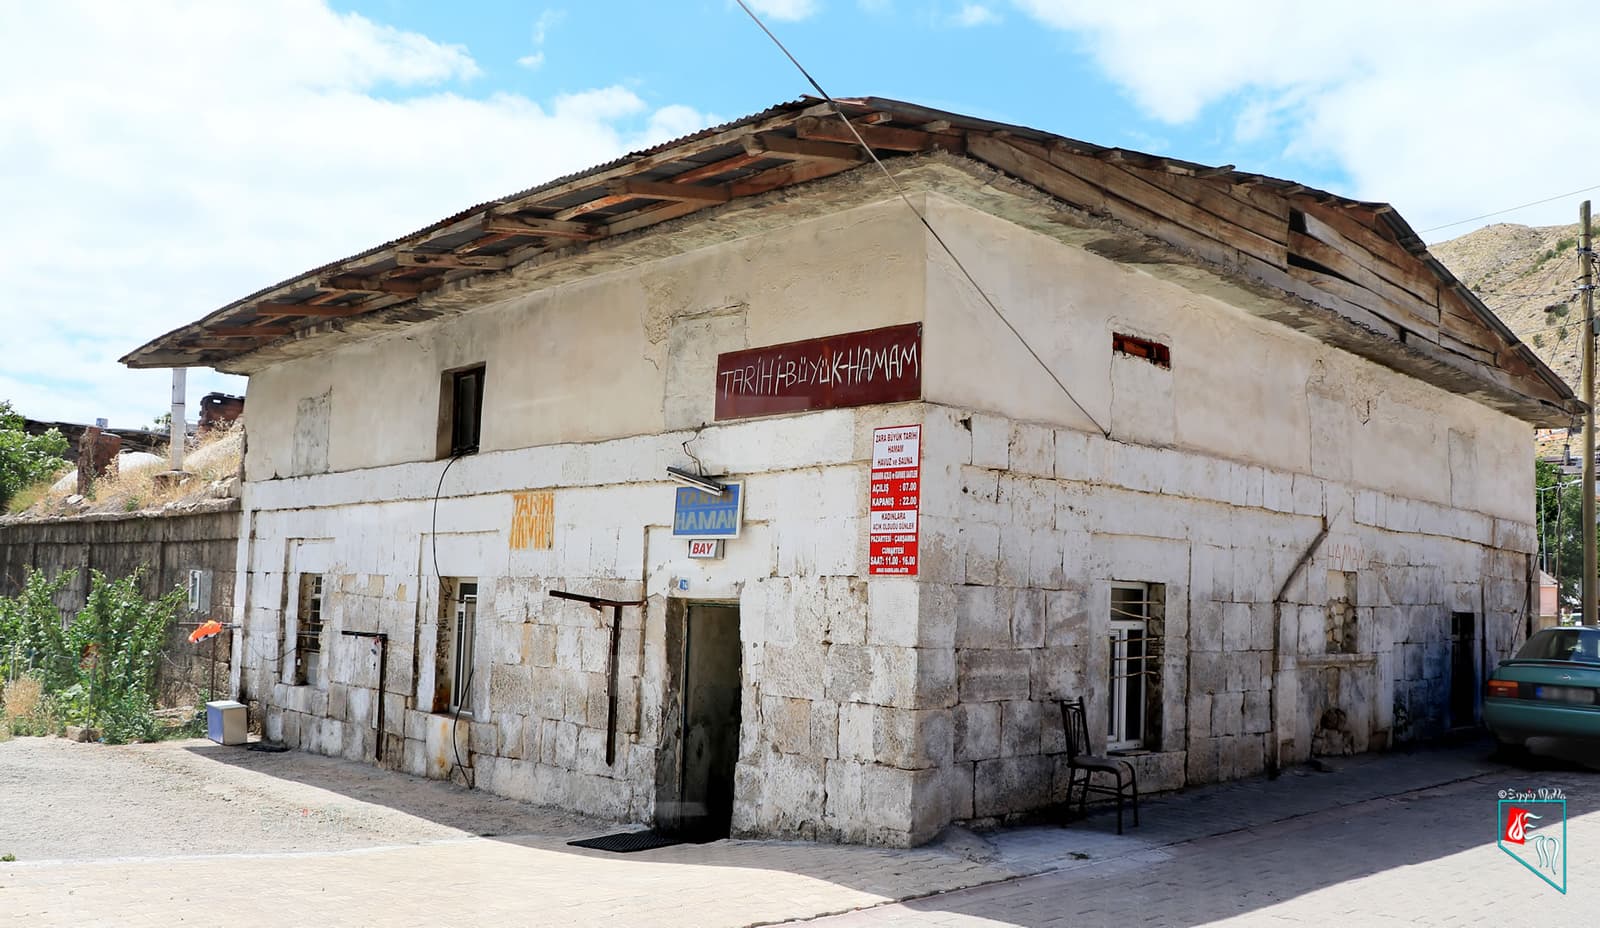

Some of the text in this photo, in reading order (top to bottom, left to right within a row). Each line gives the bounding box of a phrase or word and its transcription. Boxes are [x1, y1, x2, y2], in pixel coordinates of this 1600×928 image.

[876, 434, 887, 443] ZARA
[888, 432, 902, 442] BÜYÜK
[888, 445, 904, 453] HAMAM
[878, 457, 892, 466] HAVUZ
[898, 456, 912, 465] SAUNA
[902, 482, 917, 492] 07.00
[872, 497, 894, 508] KAPANIŞ
[902, 496, 917, 506] 22.00
[692, 543, 713, 554] BAY
[886, 556, 898, 565] 11.00
